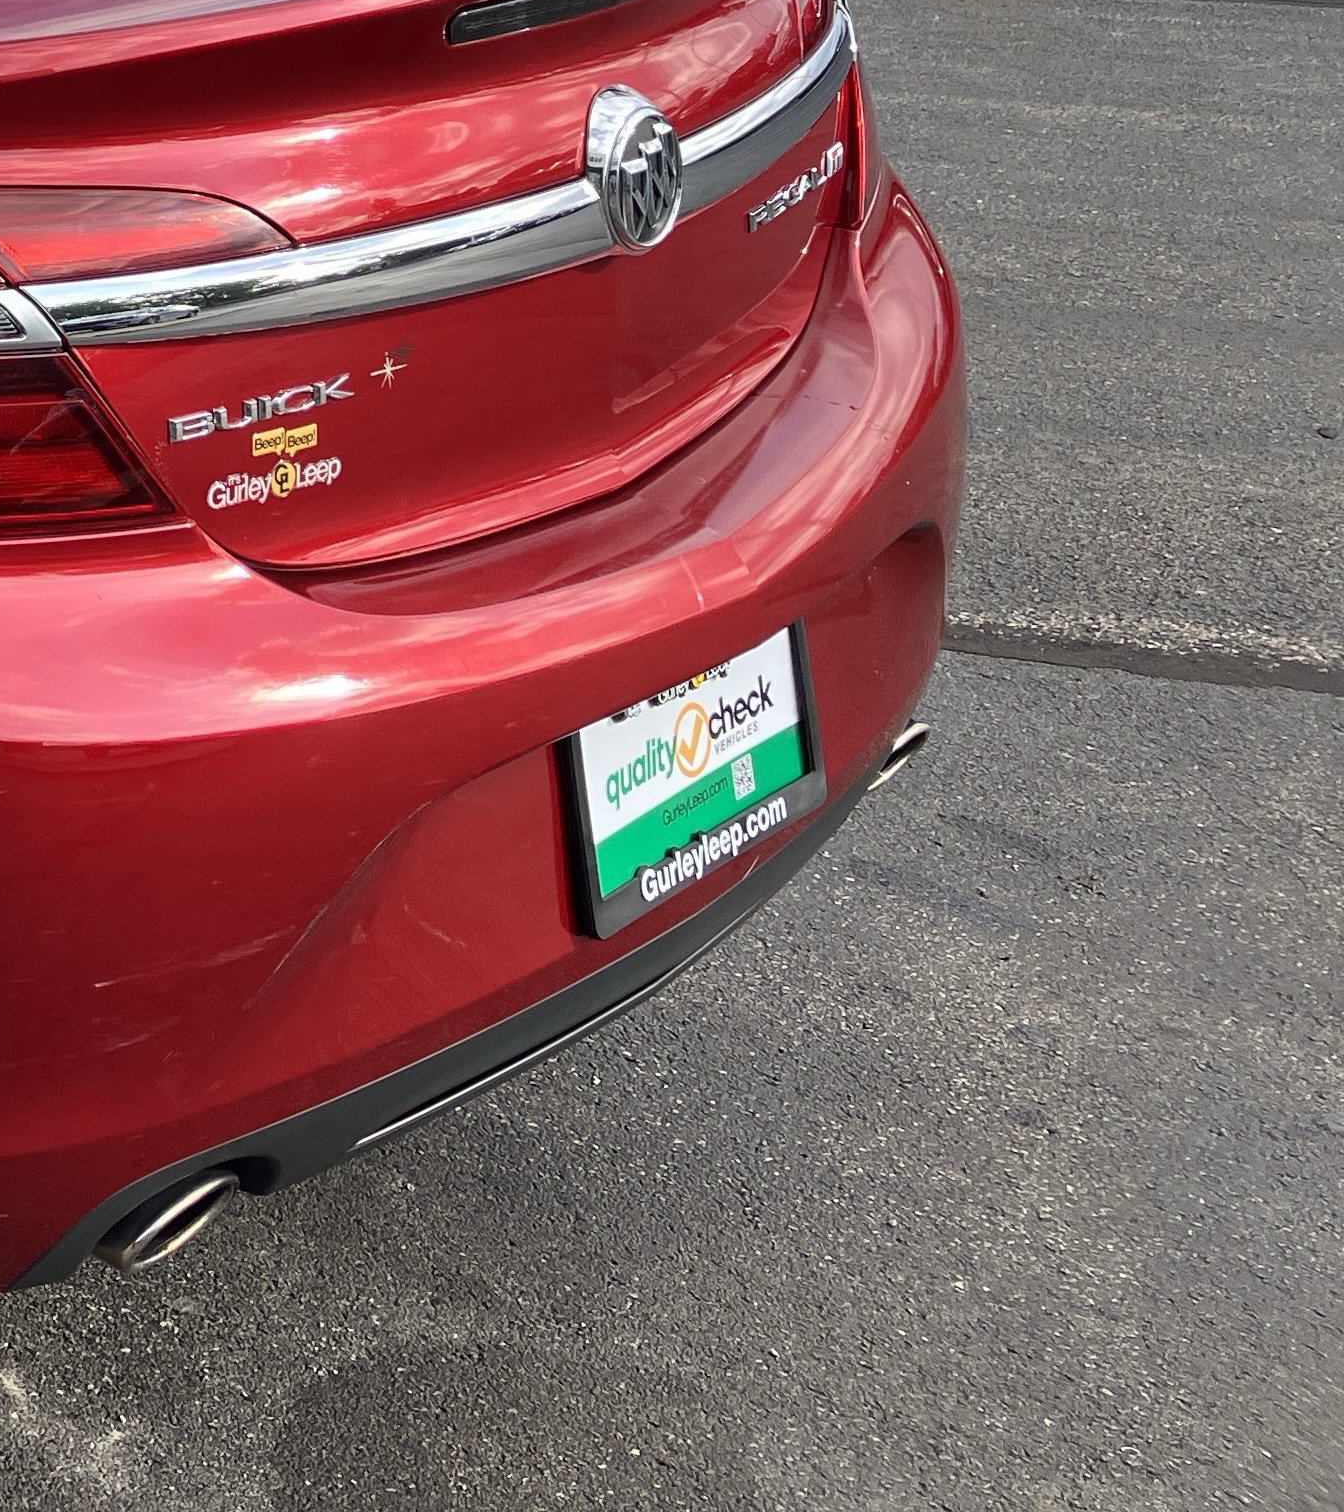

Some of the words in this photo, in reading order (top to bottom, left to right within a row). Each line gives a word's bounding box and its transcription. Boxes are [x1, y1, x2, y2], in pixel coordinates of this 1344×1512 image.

[168, 372, 355, 444] BUICK
[254, 434, 284, 451] Beep!
[287, 430, 316, 448] Beep!
[207, 472, 272, 509] Gurley
[296, 457, 342, 489] Leep
[605, 735, 677, 810] quality
[708, 675, 773, 739] check
[713, 720, 759, 755] VEHICLES
[663, 775, 729, 827] GurleyLeep.com
[640, 796, 788, 902] Gurleyleep.com
